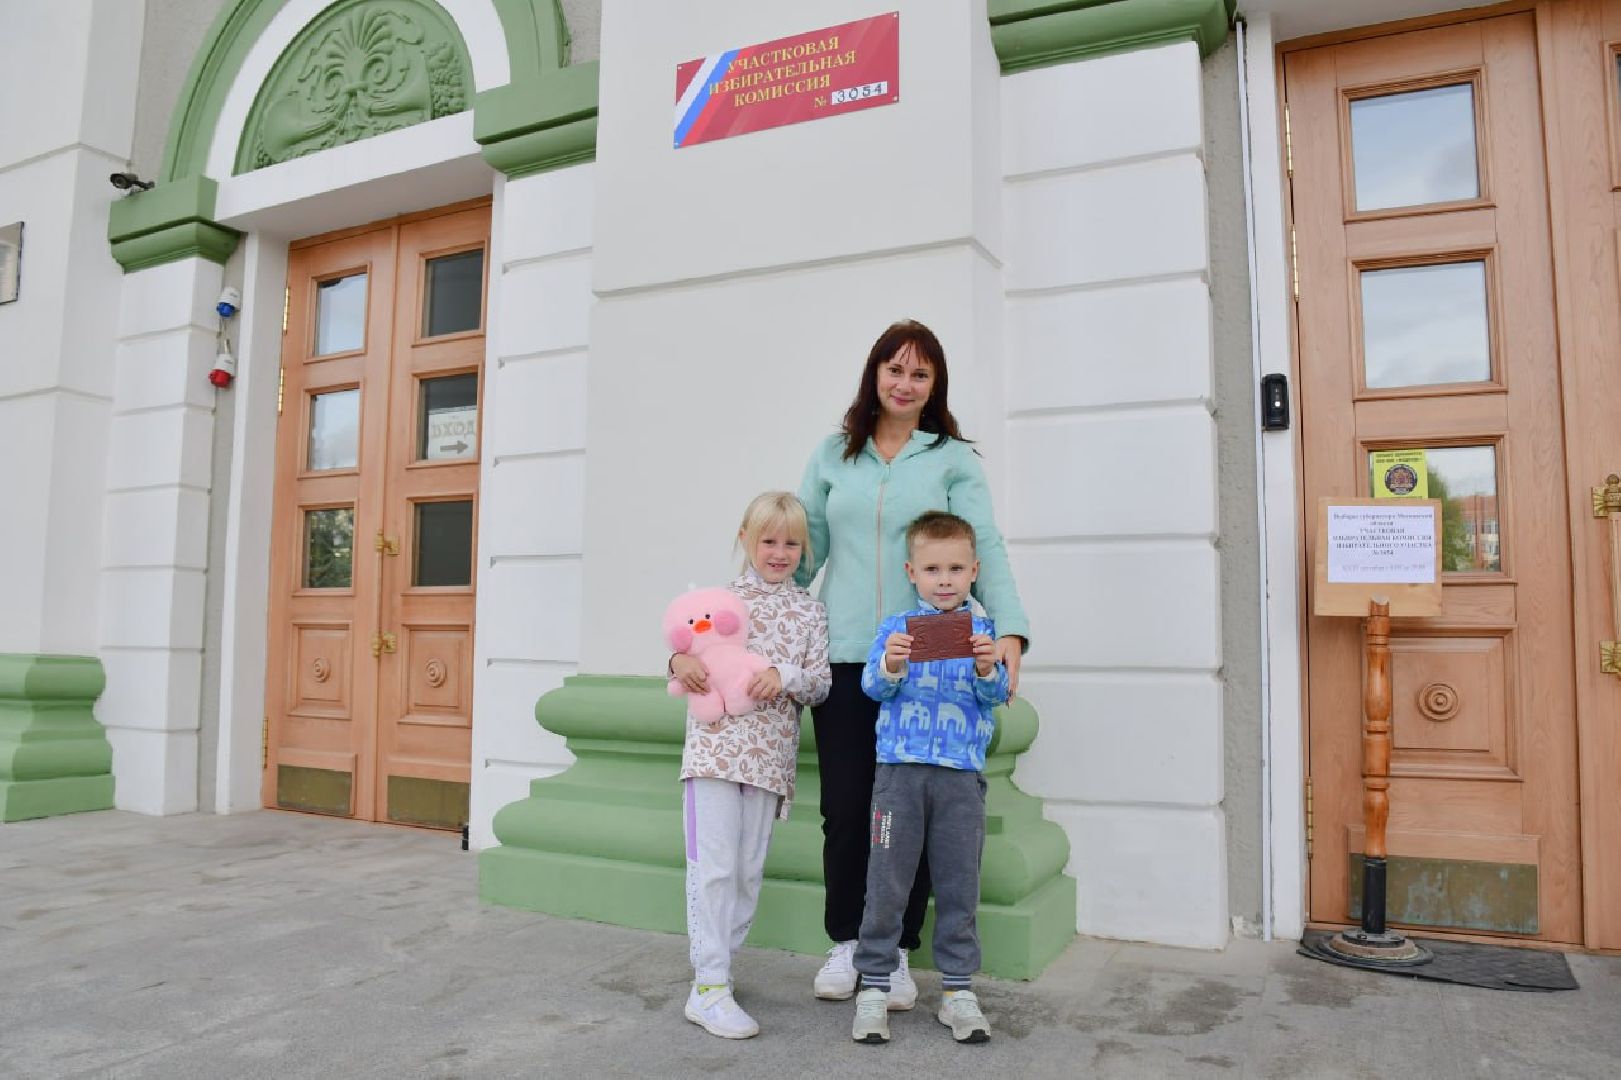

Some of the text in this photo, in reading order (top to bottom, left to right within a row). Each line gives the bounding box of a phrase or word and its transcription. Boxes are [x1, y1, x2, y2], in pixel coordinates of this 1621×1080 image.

[709, 50, 857, 96] ИЗБИРАТЕЛЬНАЯ
[727, 36, 840, 73] УЧАСТКОВАЯ
[733, 74, 831, 107] КОМИССИЯ
